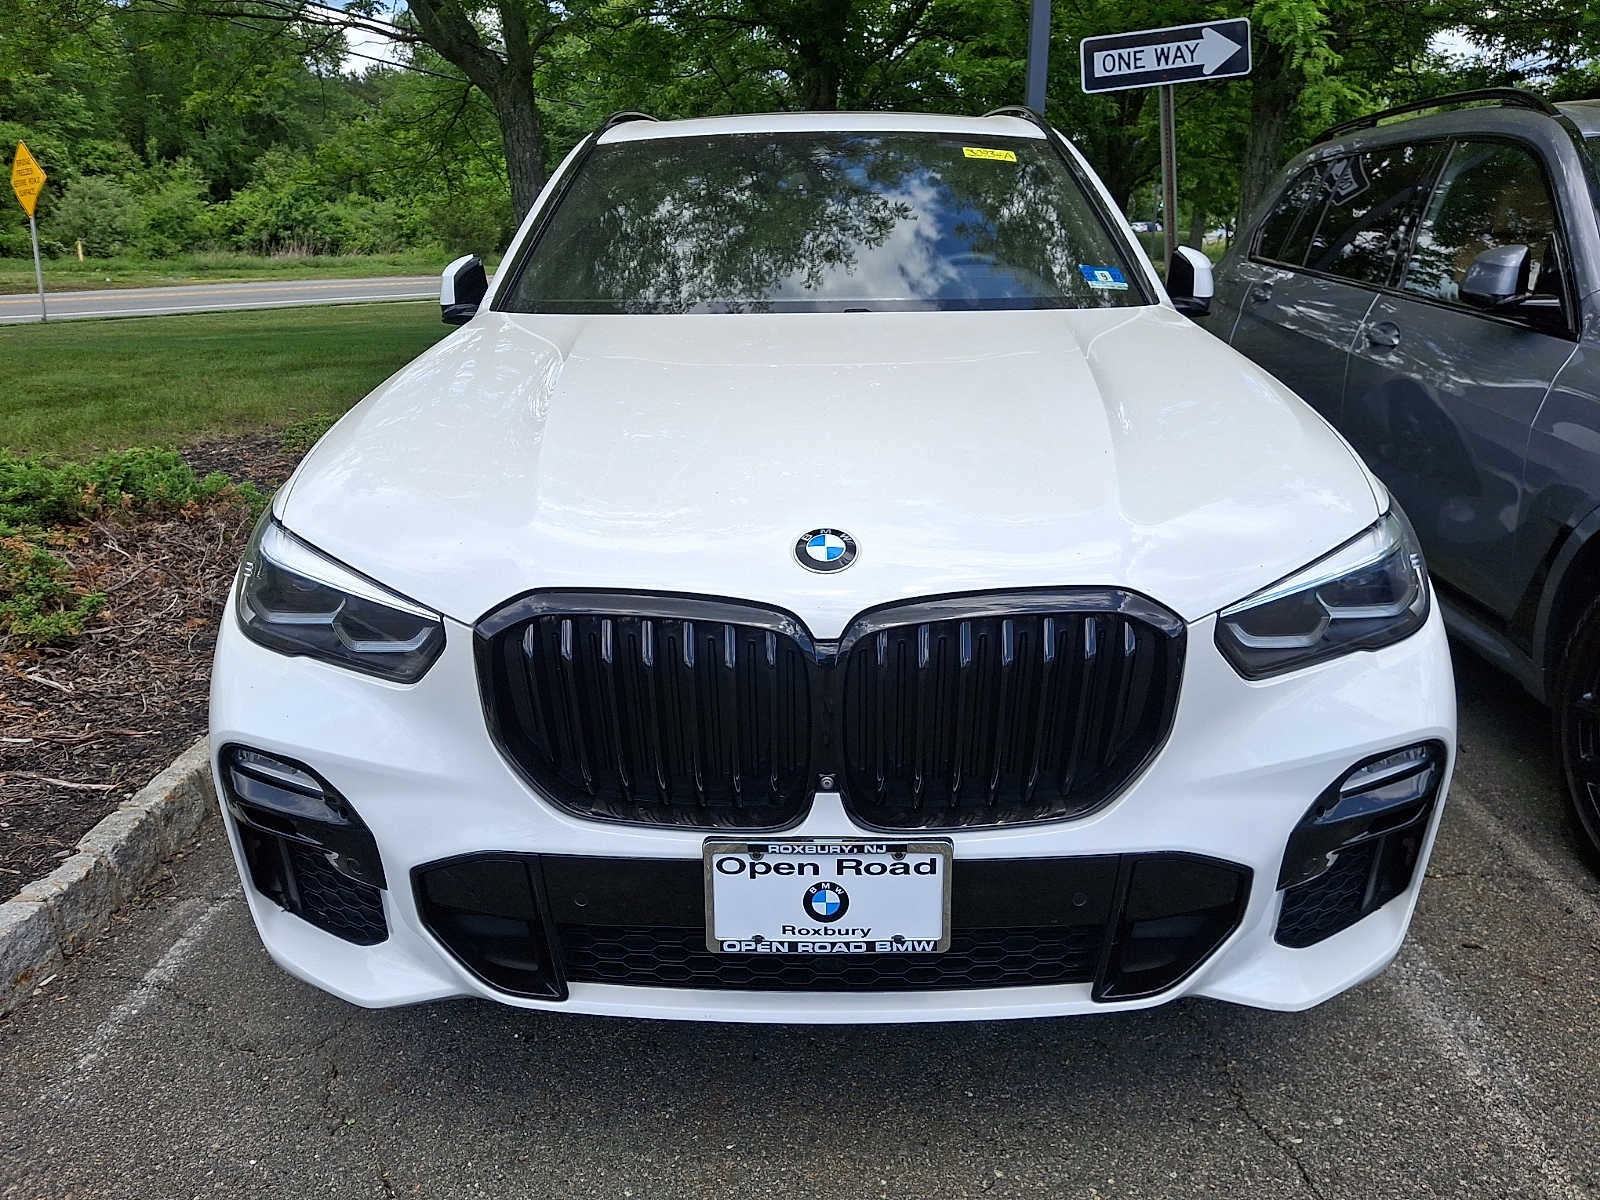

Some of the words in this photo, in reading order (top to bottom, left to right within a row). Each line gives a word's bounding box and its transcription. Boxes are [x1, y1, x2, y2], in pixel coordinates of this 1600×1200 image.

[1103, 50, 1145, 73] ONE
[1154, 42, 1200, 67] WAY
[801, 529, 852, 542] BMW
[768, 844, 858, 854] ROXBURY,
[864, 844, 887, 854] NJ
[715, 856, 820, 879] Open
[836, 857, 937, 876] Road
[809, 882, 845, 895] BMW
[782, 925, 872, 938] Roxbury
[723, 941, 789, 953] OPEN
[797, 941, 867, 953] ROAD
[875, 940, 936, 952] BMW
